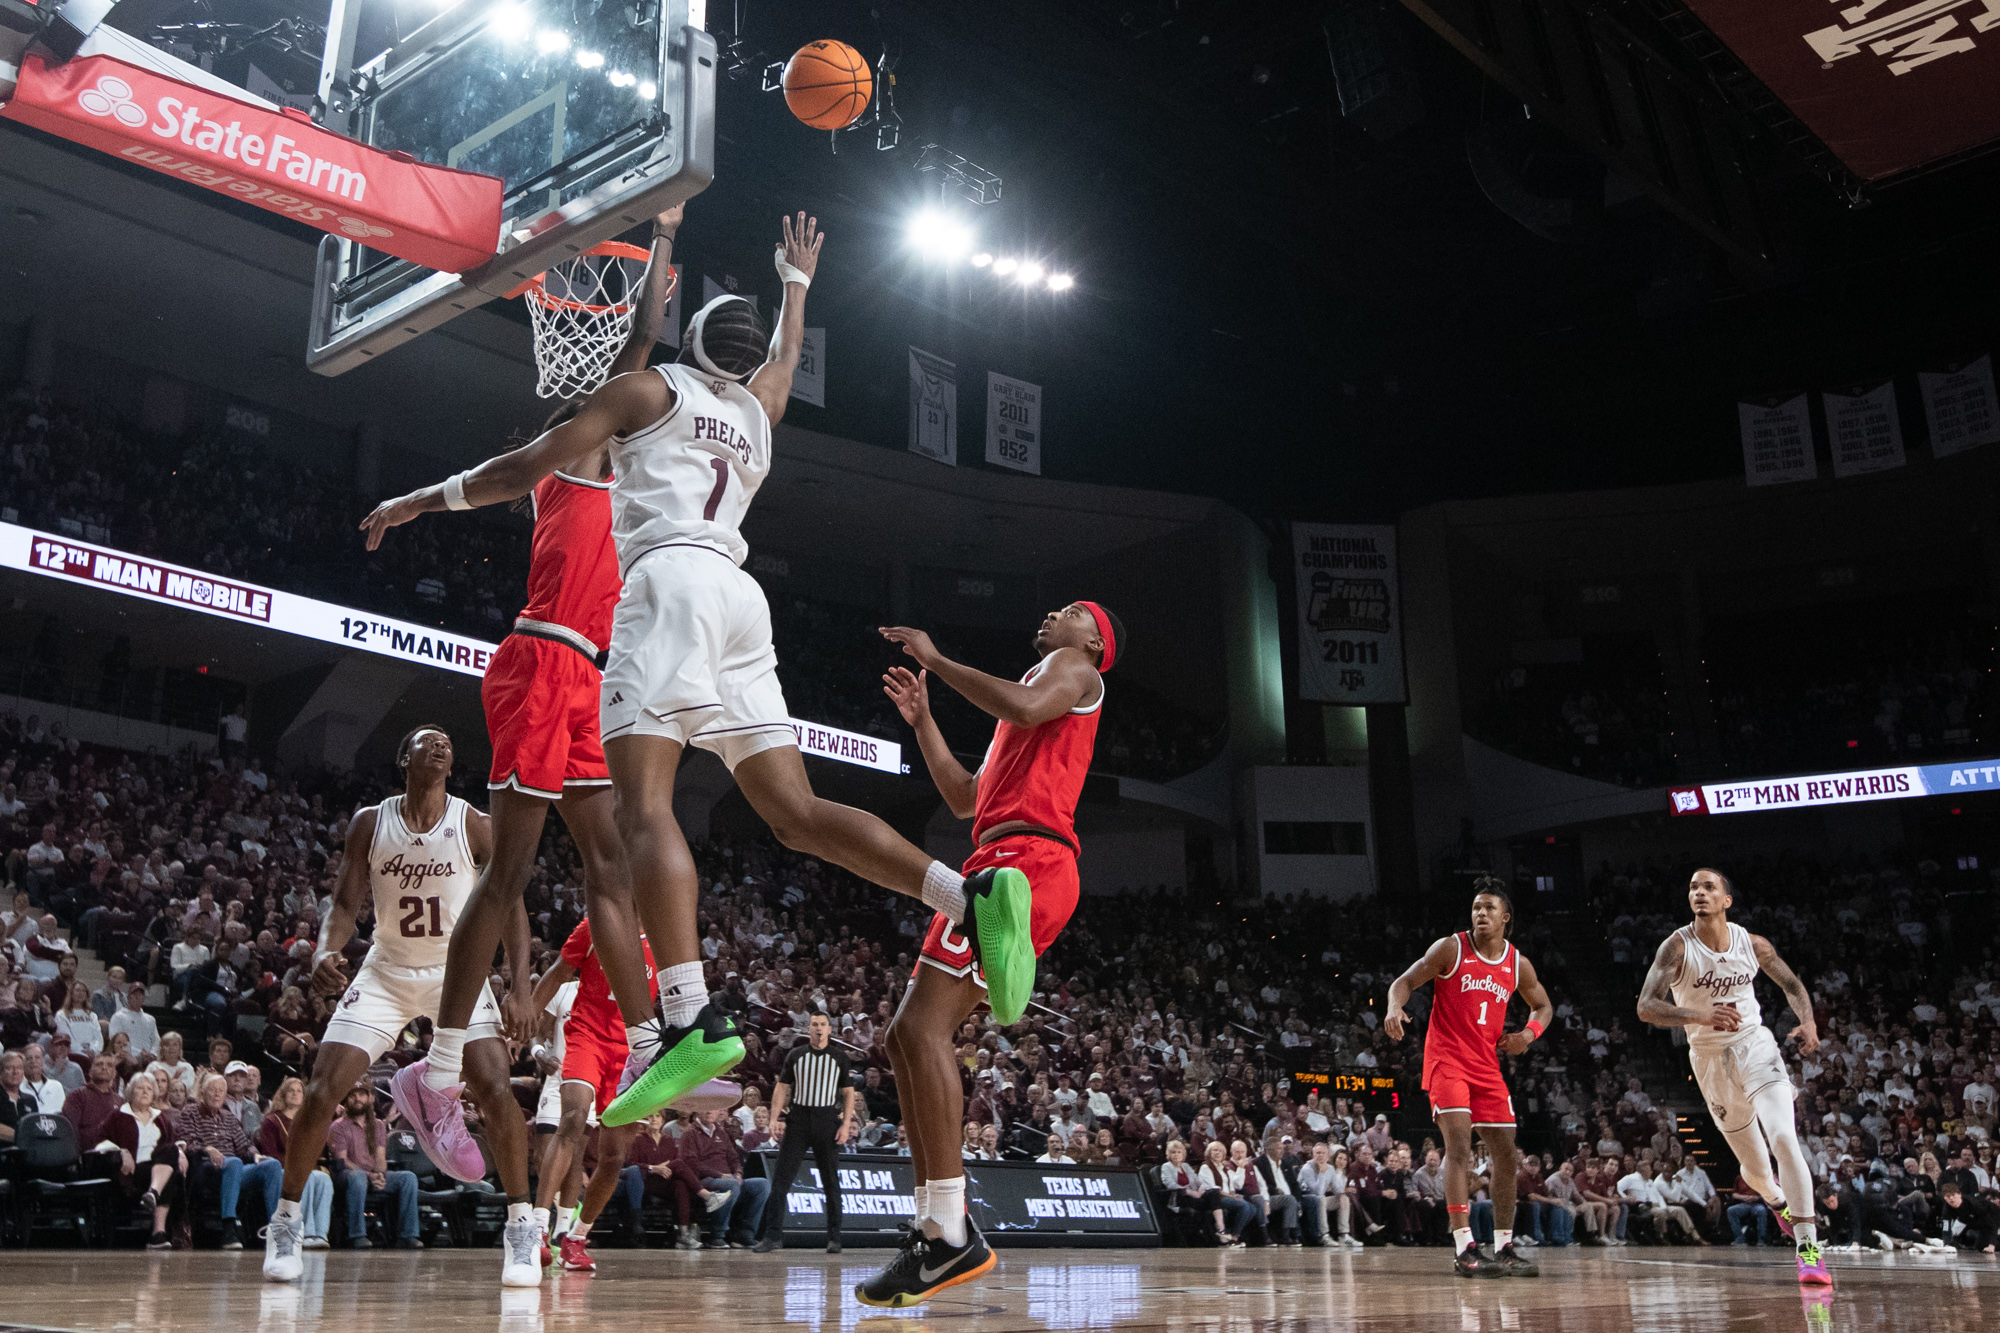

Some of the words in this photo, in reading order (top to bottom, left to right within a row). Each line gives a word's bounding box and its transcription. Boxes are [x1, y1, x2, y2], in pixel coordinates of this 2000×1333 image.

[927, 410, 938, 425] 23
[999, 400, 1029, 425] 2011
[694, 416, 752, 465] PHELPS
[999, 438, 1028, 463] 852
[703, 457, 729, 522] 1
[1310, 536, 1377, 553] NATIONAL
[1302, 553, 1388, 570] CHAMPIONS
[35, 542, 89, 570] 12TH
[93, 555, 162, 592] MAN
[166, 572, 268, 618] MOBILE
[957, 579, 994, 598] 209
[1331, 580, 1385, 600] FINAL
[1581, 586, 1618, 603] 210
[1323, 640, 1379, 664] 2011
[807, 728, 878, 763] REWARDS
[1714, 787, 1752, 808] 12TH
[1754, 783, 1801, 805] MAN
[1806, 773, 1910, 800] REWARDS
[381, 853, 456, 890] Aggies
[399, 896, 444, 937] 21
[1461, 973, 1511, 1004] Buckeyes
[1693, 970, 1752, 998] Aggies
[1477, 1001, 1489, 1026] 1
[1336, 1075, 1366, 1091] 17:34
[1391, 1092, 1400, 1108] 3
[862, 1170, 896, 1190] A&M
[1042, 1176, 1084, 1195] TEXAS
[1083, 1178, 1111, 1196] A&M
[1024, 1198, 1066, 1217] MEN'S
[1064, 1199, 1141, 1219] BASKETBALL
